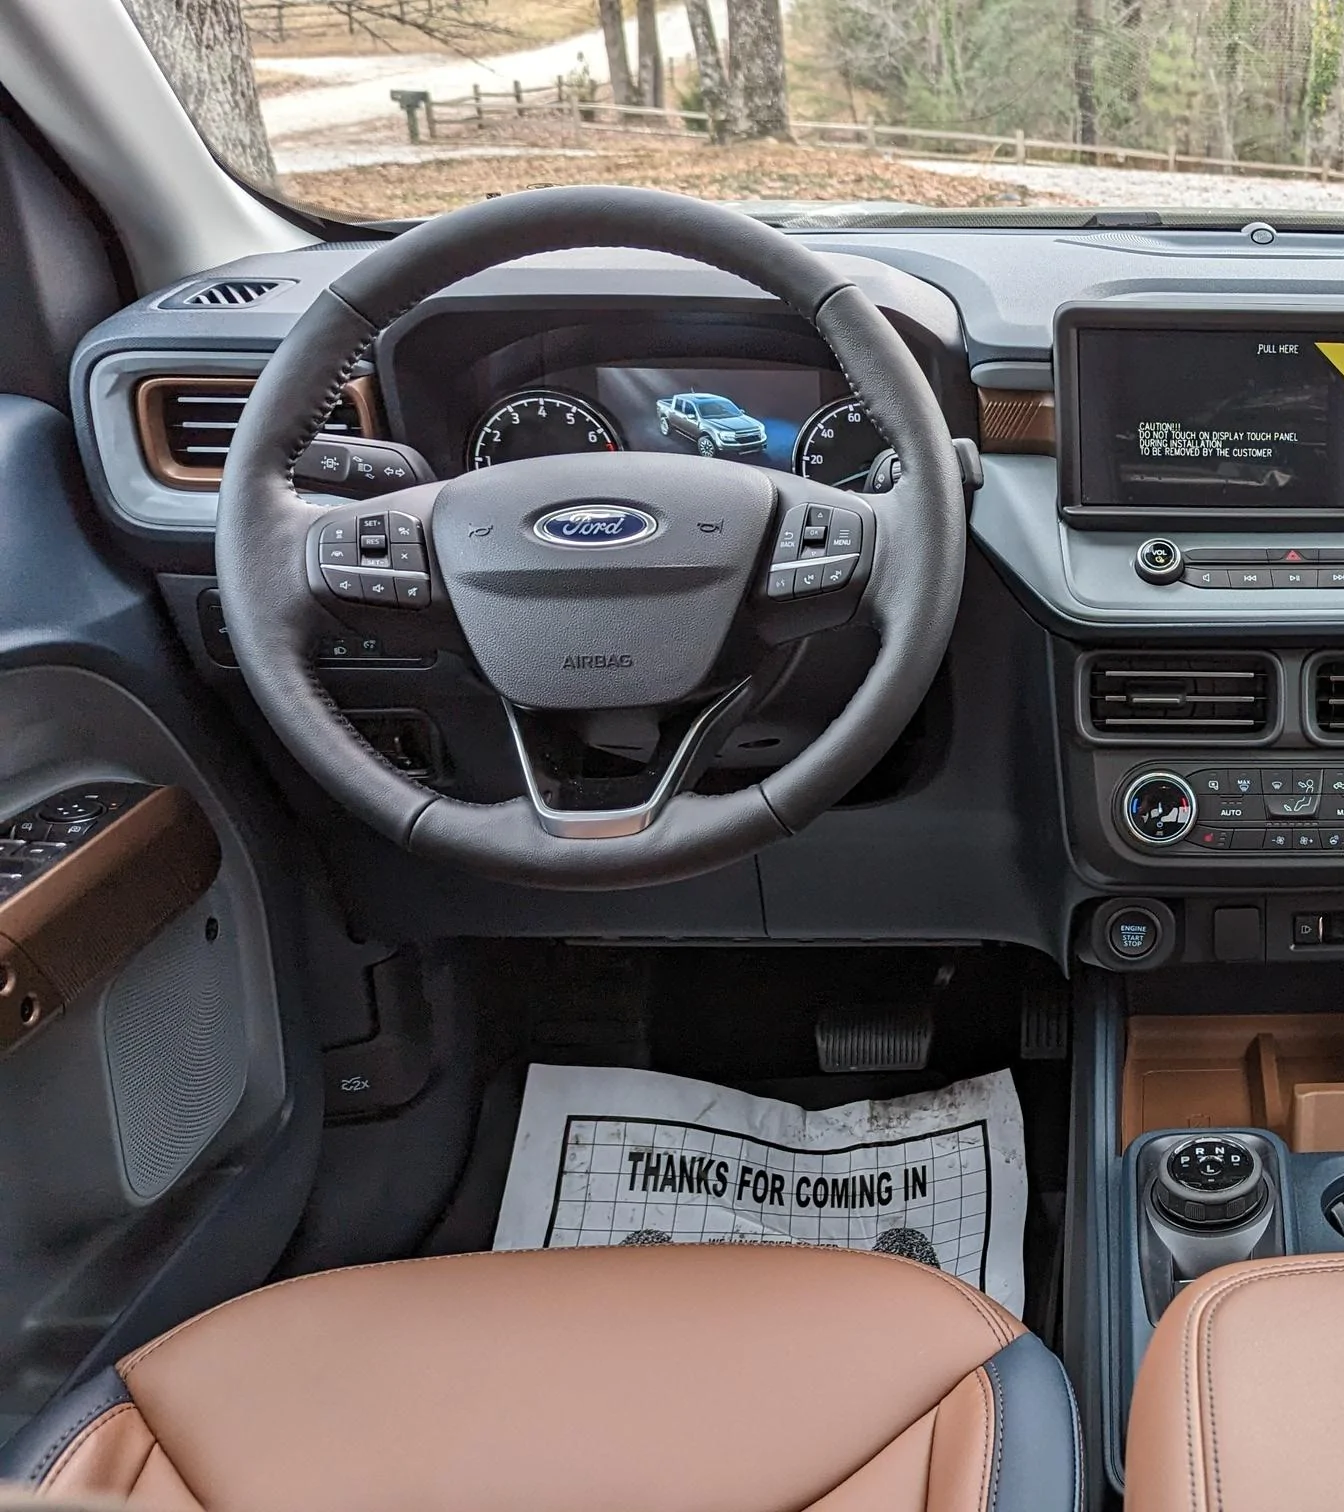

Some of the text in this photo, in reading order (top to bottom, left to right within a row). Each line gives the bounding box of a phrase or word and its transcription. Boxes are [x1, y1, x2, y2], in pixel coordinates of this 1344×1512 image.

[1257, 344, 1299, 354] PULL HERE
[492, 431, 501, 442] 2
[511, 413, 520, 424] 3
[537, 406, 547, 418] 4
[566, 413, 575, 425] 5
[588, 431, 598, 443] 6
[1139, 422, 1181, 431] CAUTION!!!
[810, 413, 861, 465] 20 40 60
[1139, 431, 1298, 442] DO NOT TOUCH ON DISPLAY TOUCH PANEL
[1170, 440, 1223, 448] INSTALLATION
[1140, 448, 1272, 457] TO BE REMOVED BY THE CUSTOMER
[562, 513, 625, 535] Ford
[560, 654, 633, 669] AIRBAG
[1180, 1146, 1241, 1164] P R N D
[628, 1152, 927, 1209] THANKS FOR COMING IN
